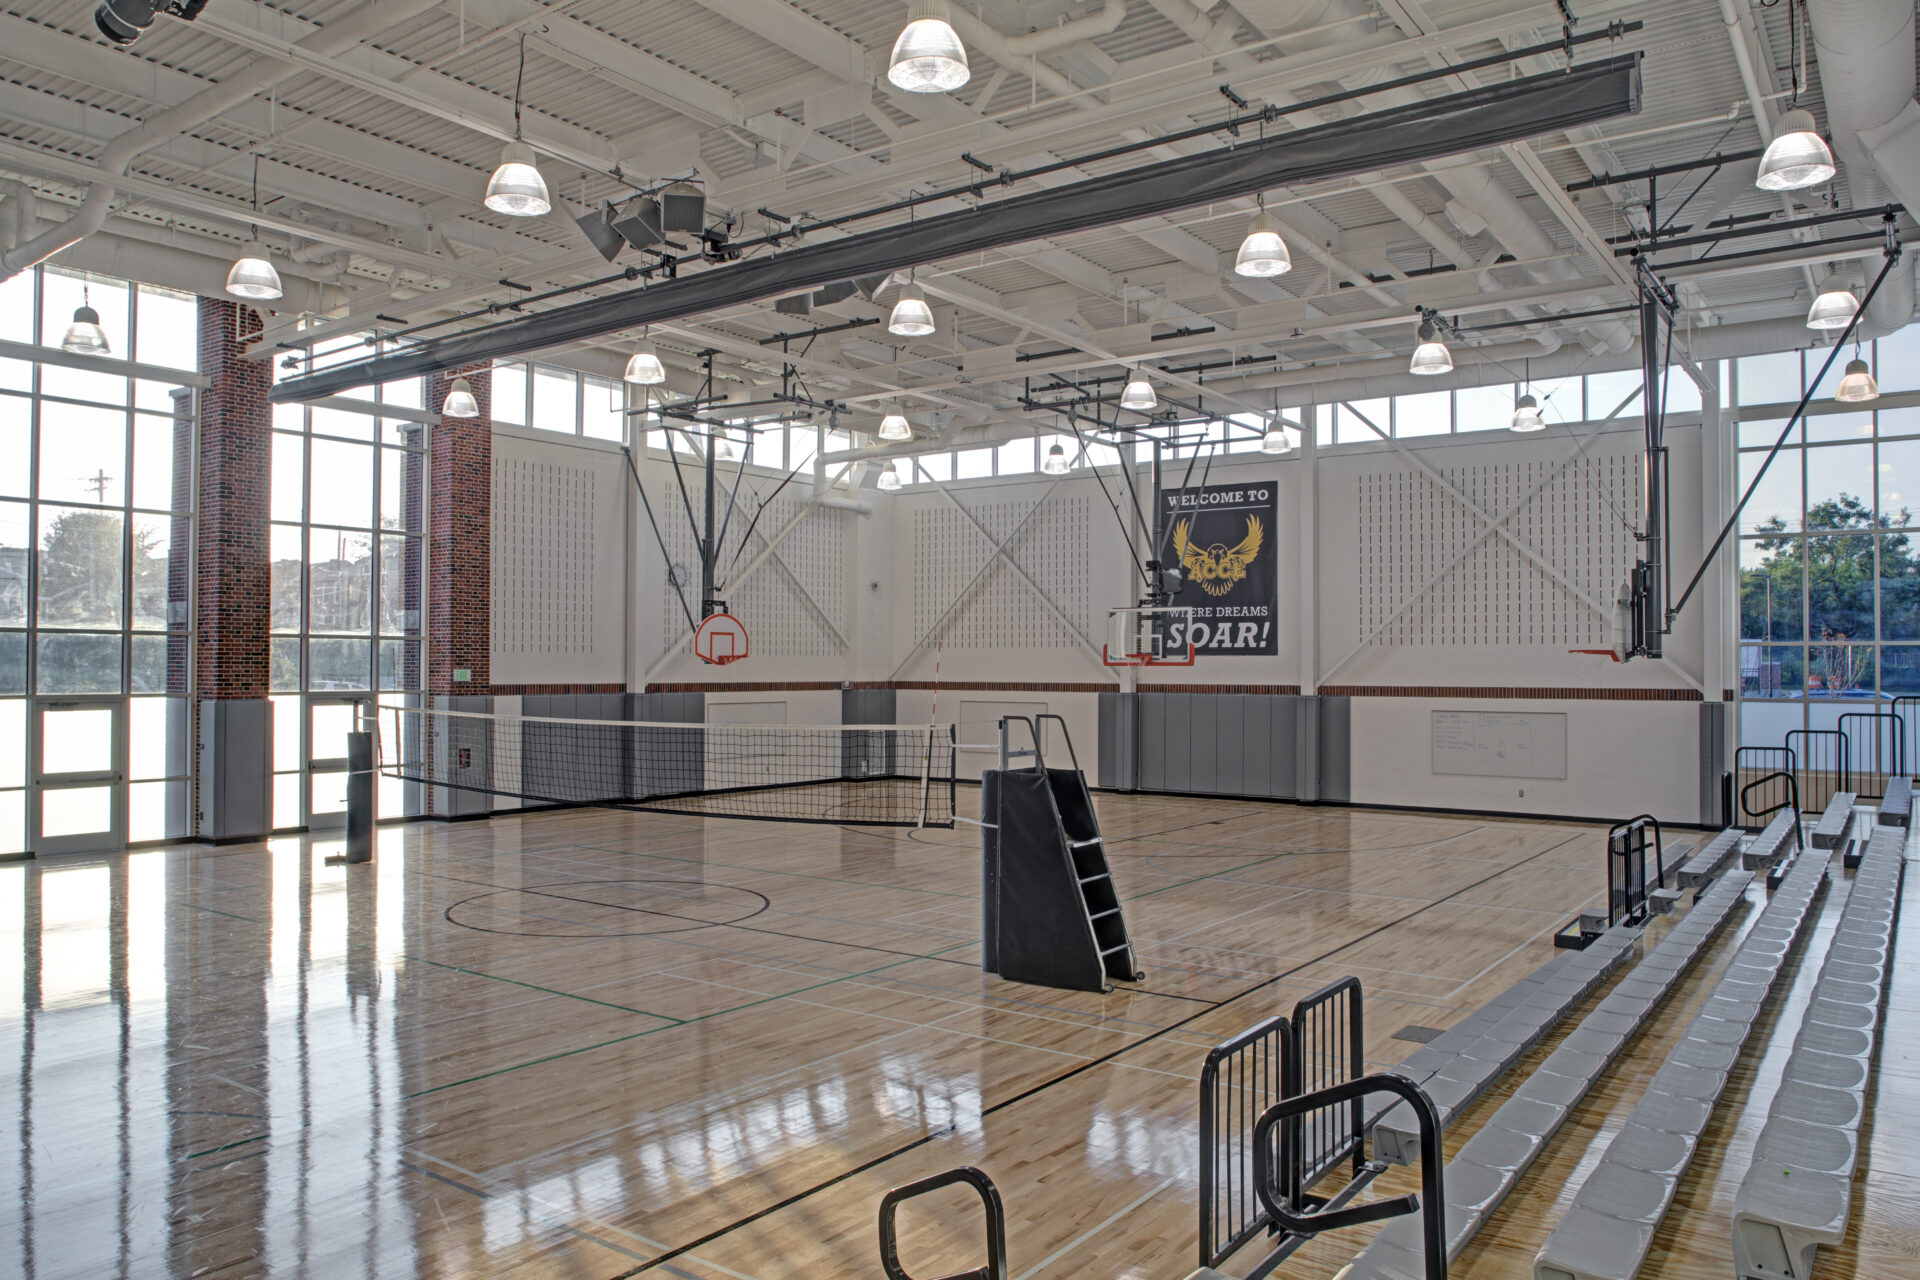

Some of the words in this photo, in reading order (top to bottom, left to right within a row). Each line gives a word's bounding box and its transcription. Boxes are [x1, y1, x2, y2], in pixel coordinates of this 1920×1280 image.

[1168, 491, 1244, 506] WELCOME
[1248, 489, 1269, 501] TO
[1188, 562, 1247, 580] ACCE
[1216, 606, 1268, 617] DREAMS
[1166, 621, 1271, 648] SOAR!
